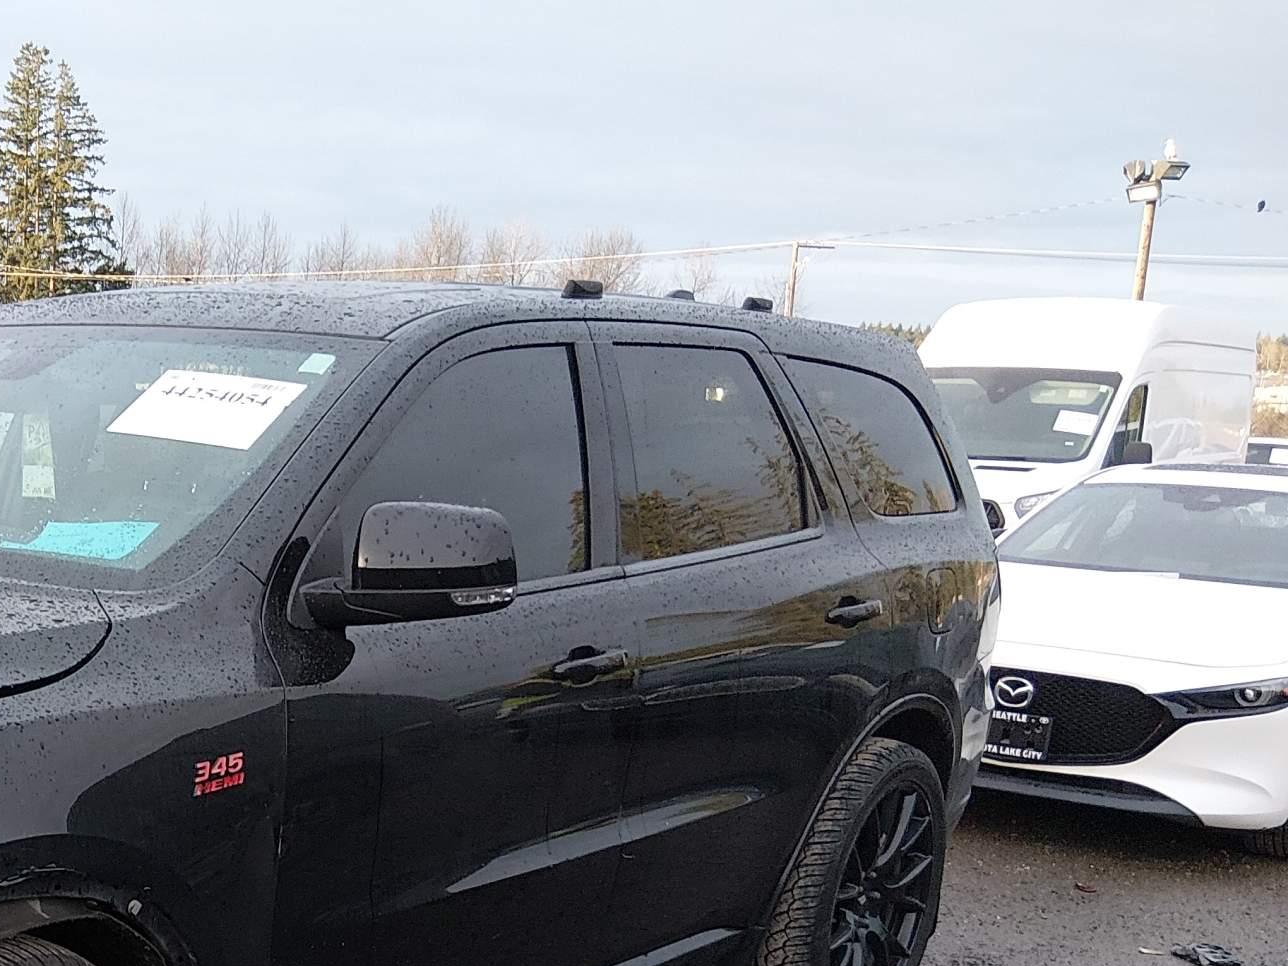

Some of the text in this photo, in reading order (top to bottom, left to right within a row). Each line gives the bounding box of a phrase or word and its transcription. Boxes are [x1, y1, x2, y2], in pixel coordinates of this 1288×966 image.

[999, 746, 1022, 758] LAKE
[1022, 749, 1043, 760] CITY
[194, 752, 244, 783] 345
[193, 771, 245, 798] HEMI
